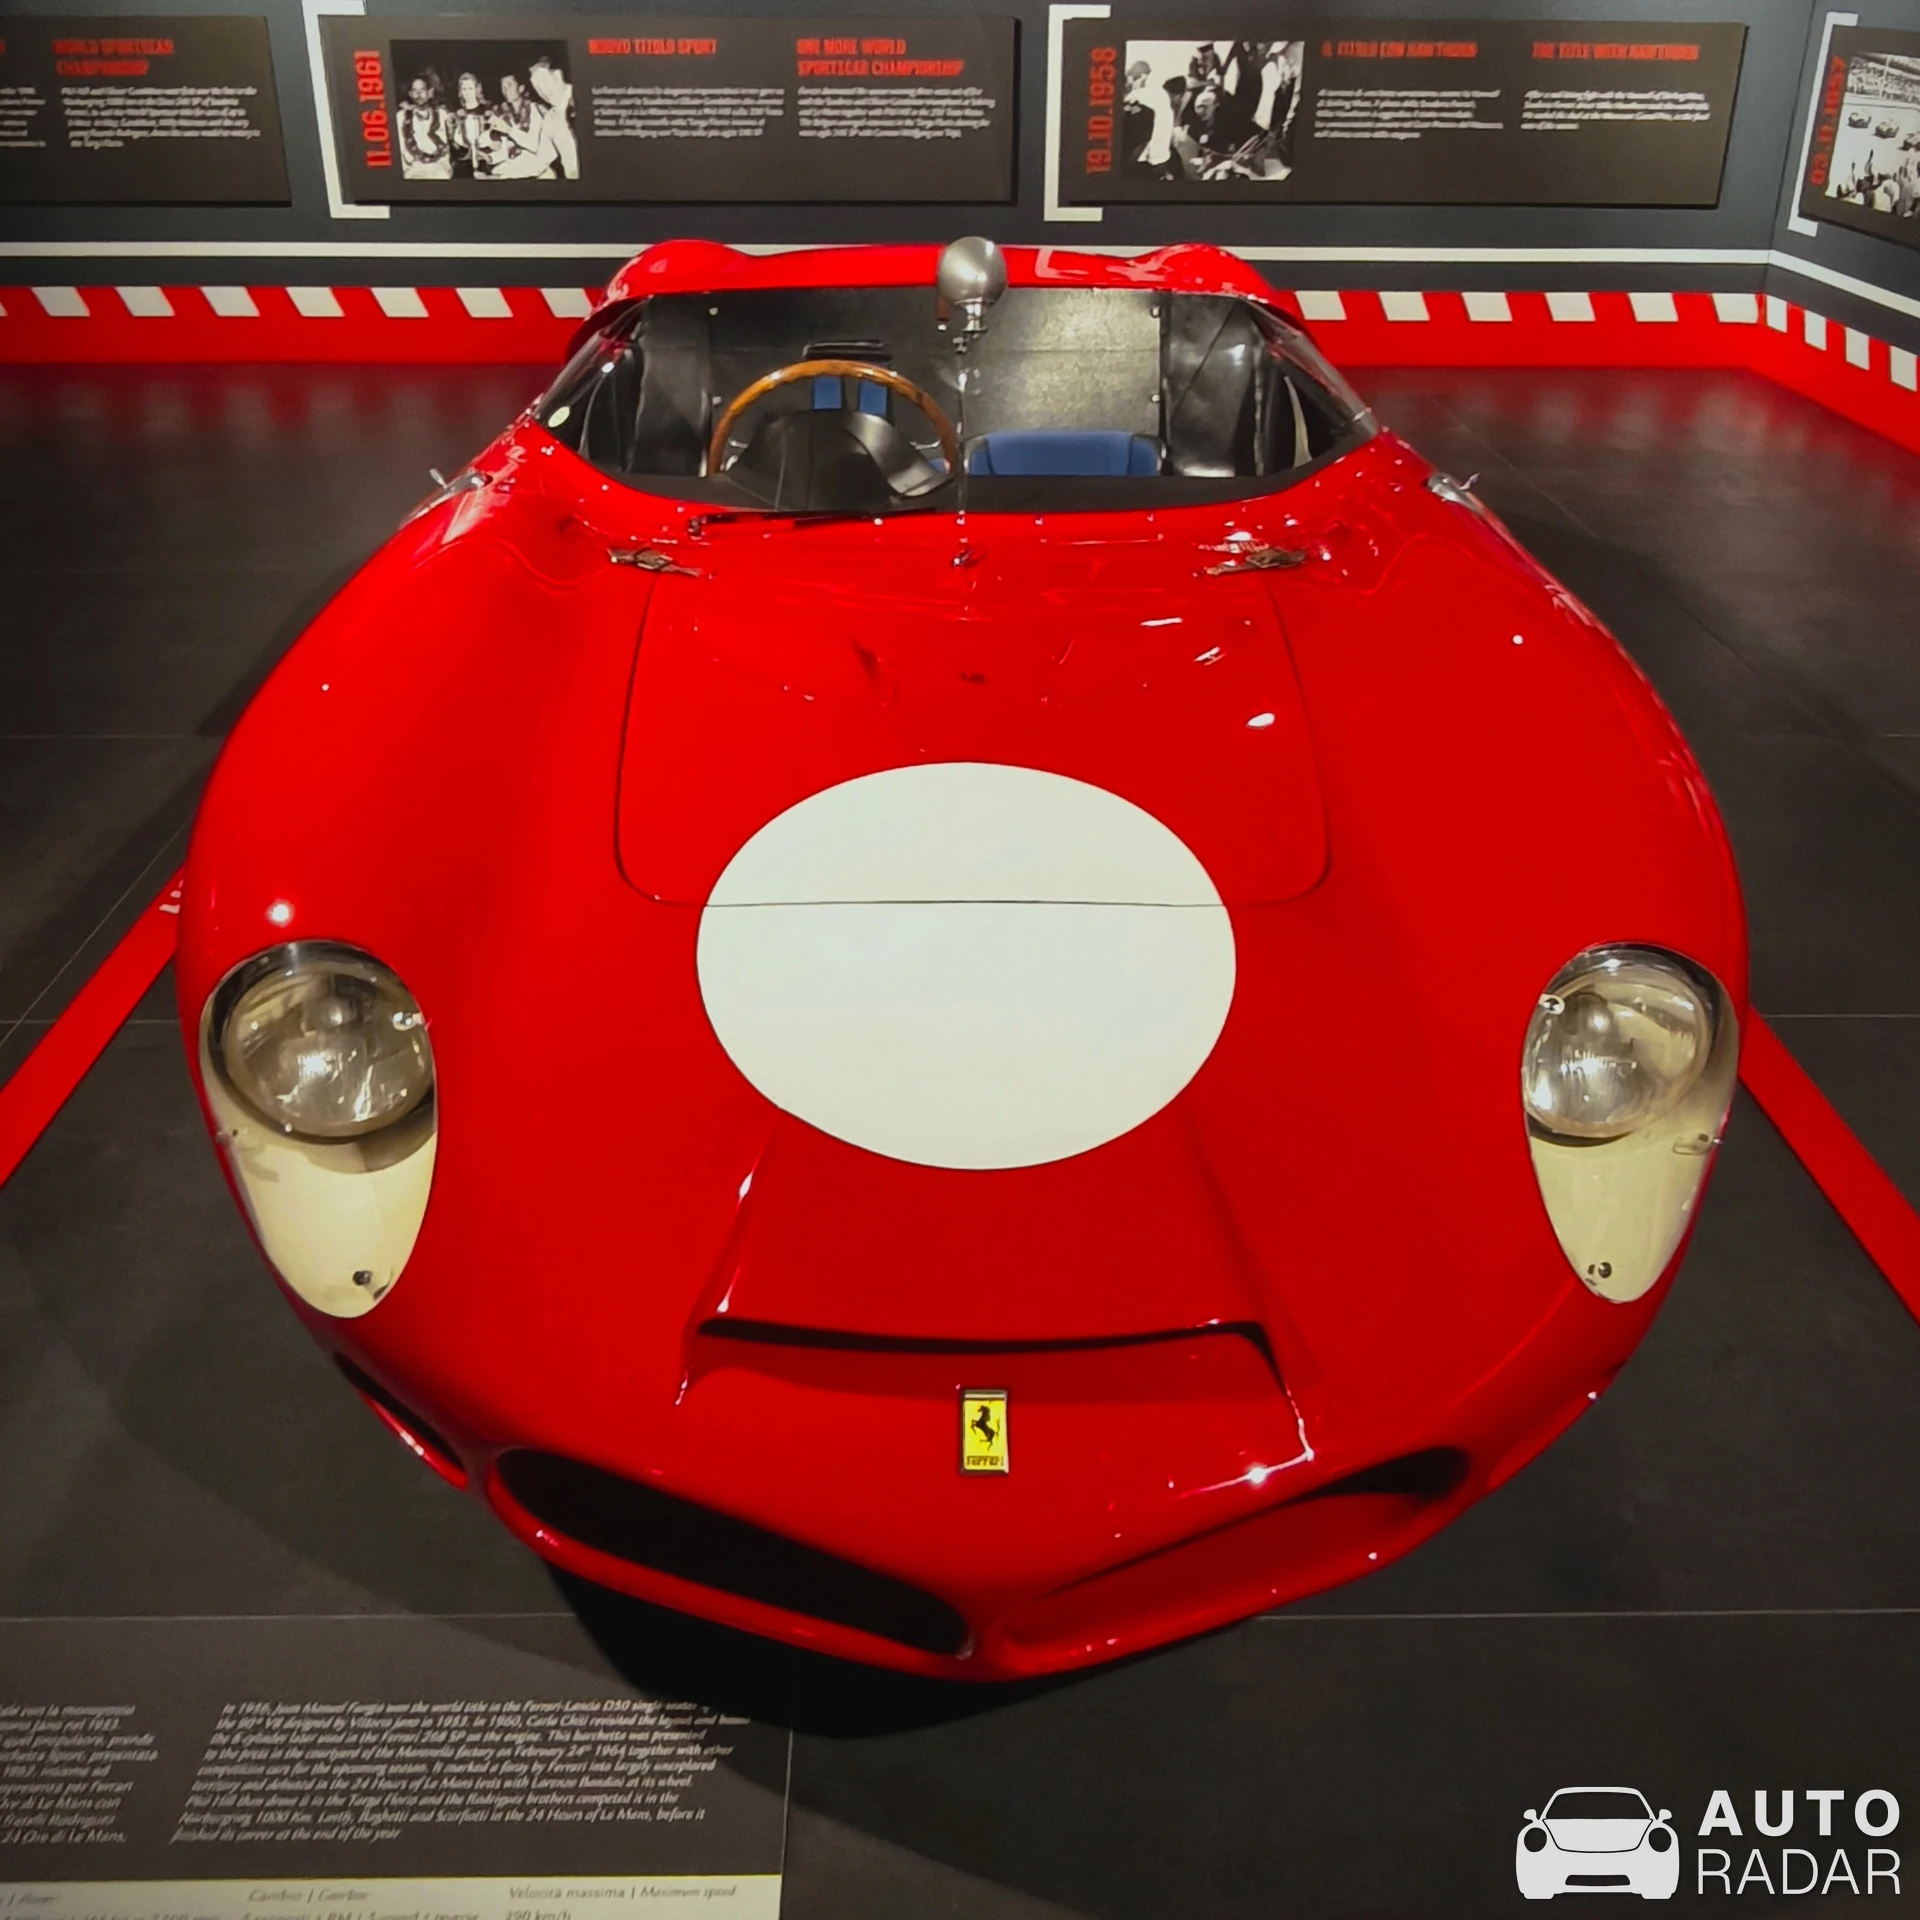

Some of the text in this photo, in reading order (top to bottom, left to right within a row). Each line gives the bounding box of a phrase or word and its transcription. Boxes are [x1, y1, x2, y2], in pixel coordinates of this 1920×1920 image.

[634, 38, 675, 55] TITOLO
[677, 38, 717, 55] SPORT
[353, 50, 391, 169] 11.06.1961
[1086, 47, 1117, 174] 19.10.1958
[966, 1455, 1004, 1466] Ferrari
[431, 1700, 463, 1713] world
[503, 1700, 523, 1712] the
[602, 1699, 632, 1711] D50
[637, 1713, 658, 1726] the
[358, 1731, 380, 1744] the
[380, 1731, 423, 1744] Ferrari
[448, 1731, 467, 1743] SP
[482, 1730, 504, 1743] the
[548, 1730, 571, 1743] This
[650, 1729, 708, 1745] presented
[375, 1746, 396, 1759] the
[454, 1746, 498, 1761] factory
[513, 1745, 567, 1761] February
[629, 1744, 676, 1760] together
[676, 1744, 702, 1756] with
[702, 1744, 734, 1756] other
[310, 1762, 332, 1775] the
[531, 1761, 549, 1776] by
[547, 1760, 588, 1773] Ferrari
[588, 1760, 613, 1773] into
[613, 1760, 652, 1775] largely
[329, 1778, 351, 1790] the
[371, 1778, 408, 1790] Hours
[408, 1777, 427, 1793] of
[439, 1777, 475, 1790] Mans
[502, 1777, 531, 1789] with
[531, 1776, 578, 1789] Lorenzo
[418, 1793, 445, 1806] and
[444, 1793, 467, 1805] the
[526, 1792, 574, 1805] brothers
[659, 1792, 680, 1804] the
[409, 1810, 437, 1822] and
[504, 1809, 525, 1822] the
[525, 1809, 546, 1821] 24
[546, 1809, 585, 1821] Hours
[584, 1809, 602, 1824] of
[599, 1809, 618, 1821] Le
[656, 1808, 695, 1824] before
[290, 1828, 312, 1840] the
[312, 1827, 342, 1840] end
[353, 1827, 374, 1840] the
[566, 1887, 625, 1899] massima
